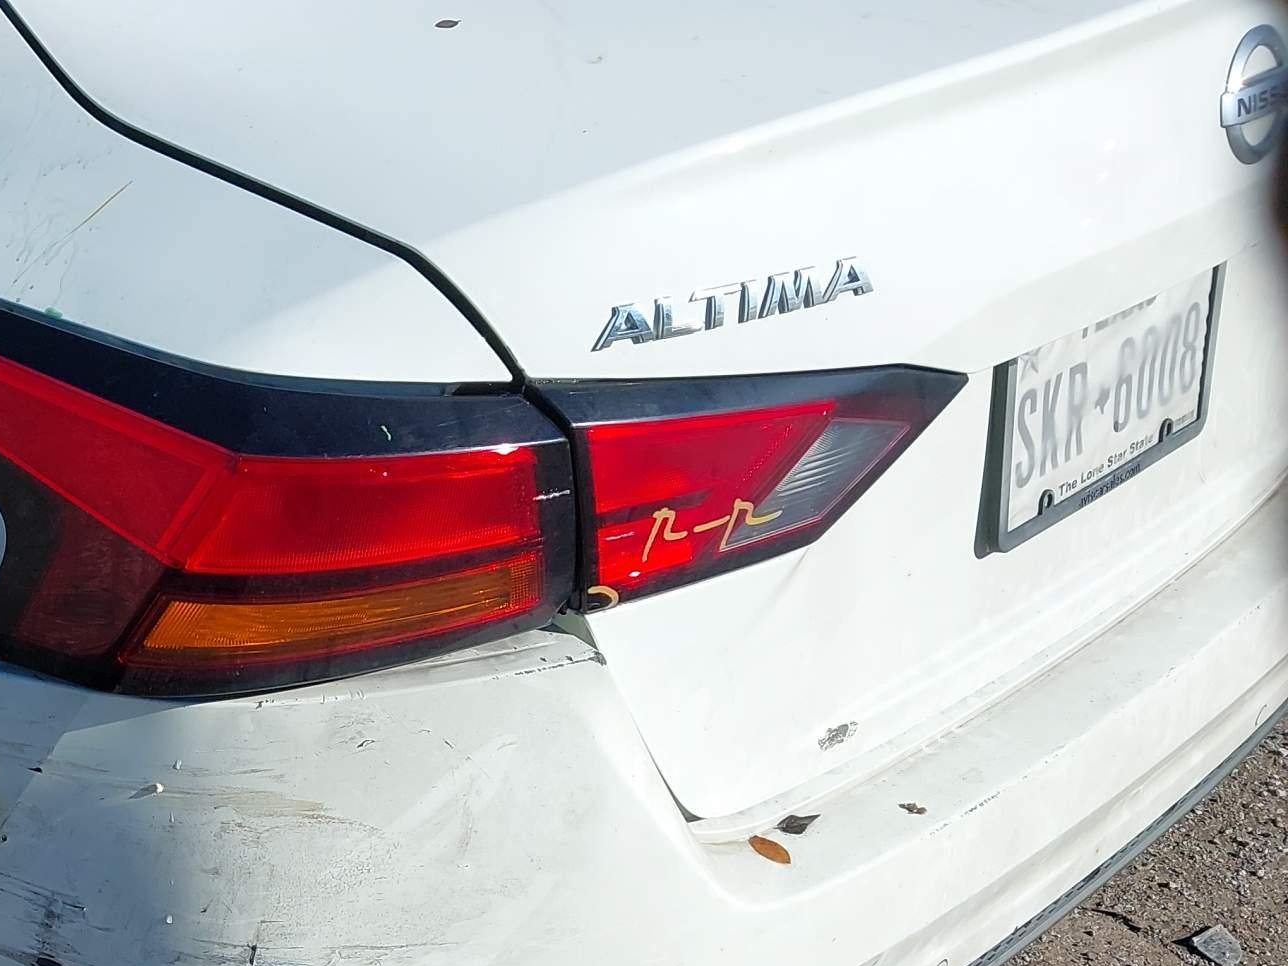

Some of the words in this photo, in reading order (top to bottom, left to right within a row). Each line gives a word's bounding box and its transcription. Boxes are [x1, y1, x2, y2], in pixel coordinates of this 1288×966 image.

[591, 256, 874, 352] ALTIMA
[1015, 361, 1088, 488] SKR
[1113, 302, 1201, 433] 6008
[1058, 480, 1078, 497] The
[1081, 464, 1105, 484] Lone
[1107, 449, 1128, 468] Star
[1129, 433, 1155, 455] State
